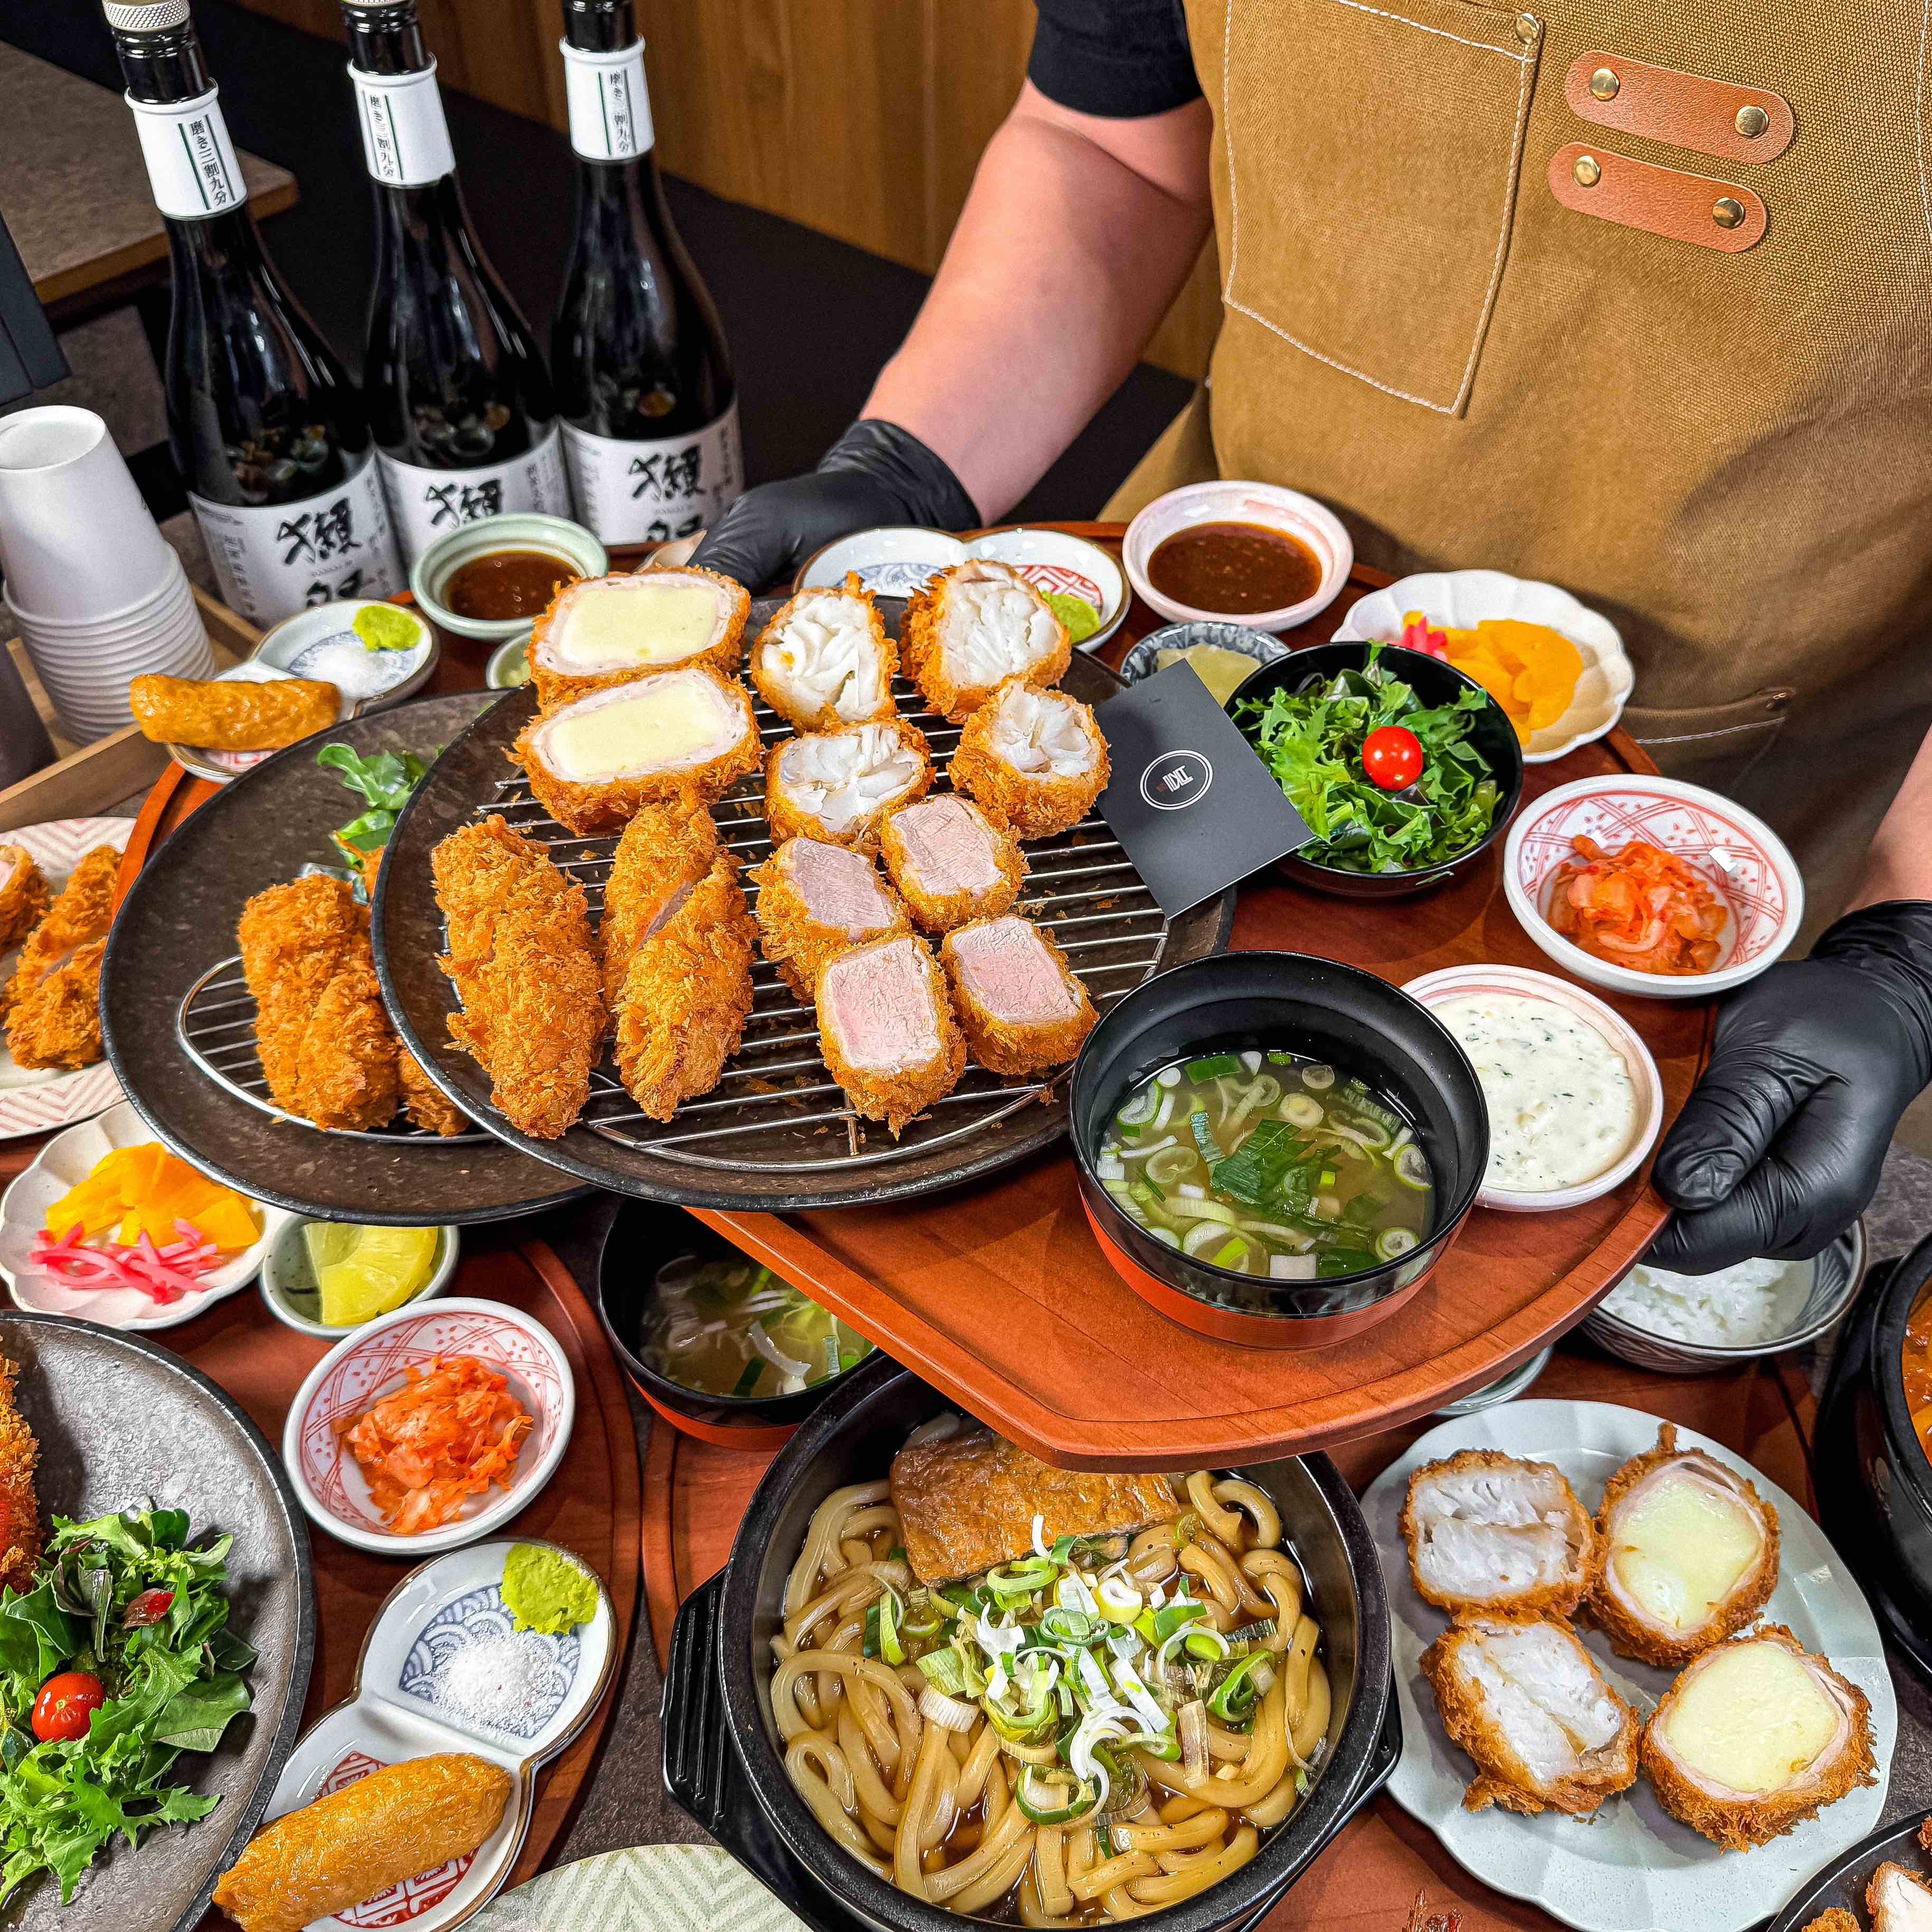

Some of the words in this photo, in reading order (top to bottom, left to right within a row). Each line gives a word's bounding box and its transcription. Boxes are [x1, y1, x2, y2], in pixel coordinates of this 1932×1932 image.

[190, 119, 227, 206] 磨き三割九分
